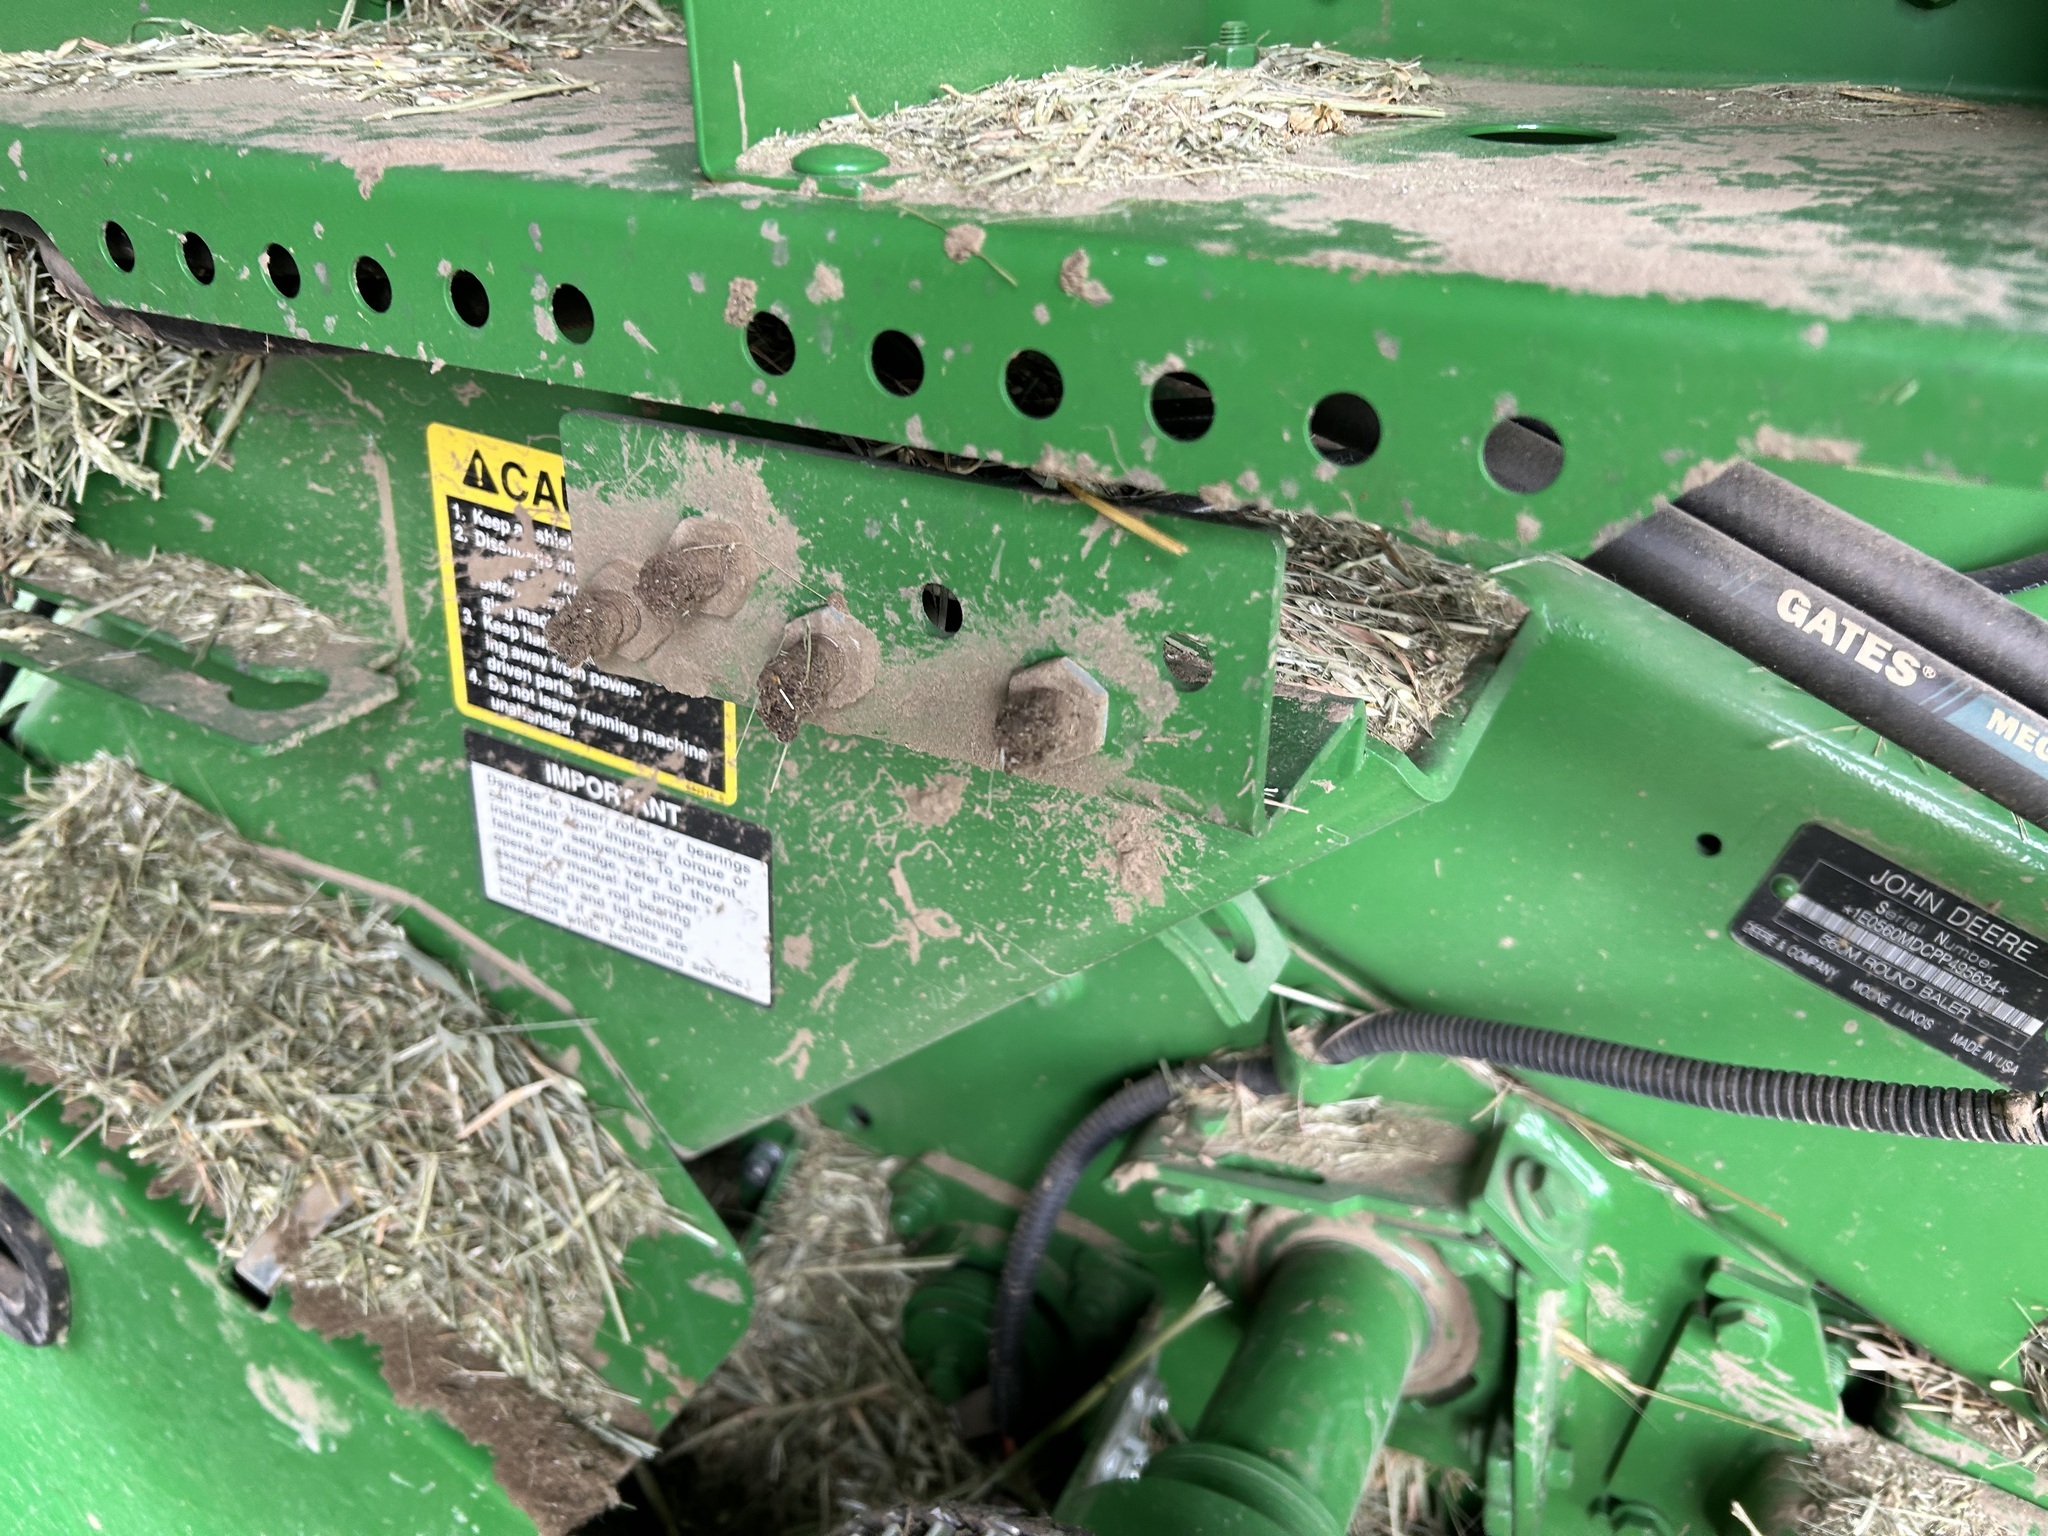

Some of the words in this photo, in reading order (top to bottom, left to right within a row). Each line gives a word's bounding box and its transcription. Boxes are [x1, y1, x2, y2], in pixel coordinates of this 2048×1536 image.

[452, 503, 466, 521] 1.
[472, 508, 511, 536] Keep
[454, 524, 468, 543] 2.
[462, 607, 476, 626] 3.
[482, 613, 520, 642] Keep
[484, 632, 508, 660] ing
[511, 645, 548, 672] away
[487, 655, 532, 683] driven
[468, 667, 482, 686] 4.
[487, 672, 509, 695] Do
[511, 684, 535, 704] not
[539, 690, 577, 719] leave
[580, 708, 639, 742] running
[642, 728, 708, 762] machine
[487, 773, 541, 802] Damage
[687, 842, 750, 876] bearings
[490, 802, 562, 837] installation
[681, 870, 736, 902] prevent
[519, 798, 556, 819] result
[605, 829, 667, 862] improper
[678, 854, 724, 882] torque
[733, 875, 747, 888] or
[491, 817, 532, 840] failure
[626, 866, 659, 886] refer
[668, 880, 681, 894] to
[690, 888, 712, 906] the
[566, 857, 617, 884] manual
[624, 878, 644, 894] for
[652, 889, 697, 917] proper
[566, 872, 600, 892] drive
[607, 886, 629, 904] roll
[638, 898, 690, 928] bearing
[579, 890, 604, 907] and
[612, 902, 682, 940] tightening
[1870, 869, 1944, 914] JOHN
[1946, 906, 2039, 961] DEERE
[592, 910, 615, 928] any
[666, 938, 687, 953] are
[608, 927, 683, 967] performing
[1875, 900, 1925, 933] Serial
[1933, 931, 1998, 969] Number
[1741, 920, 1779, 947] DEERE
[1786, 944, 1840, 977] COMPANY
[1950, 1032, 1984, 1056] MADE
[1981, 1050, 1997, 1063] IN
[1995, 1055, 2019, 1076] USA
[1863, 957, 1916, 990] ROUND
[1919, 985, 1971, 1019] BALER
